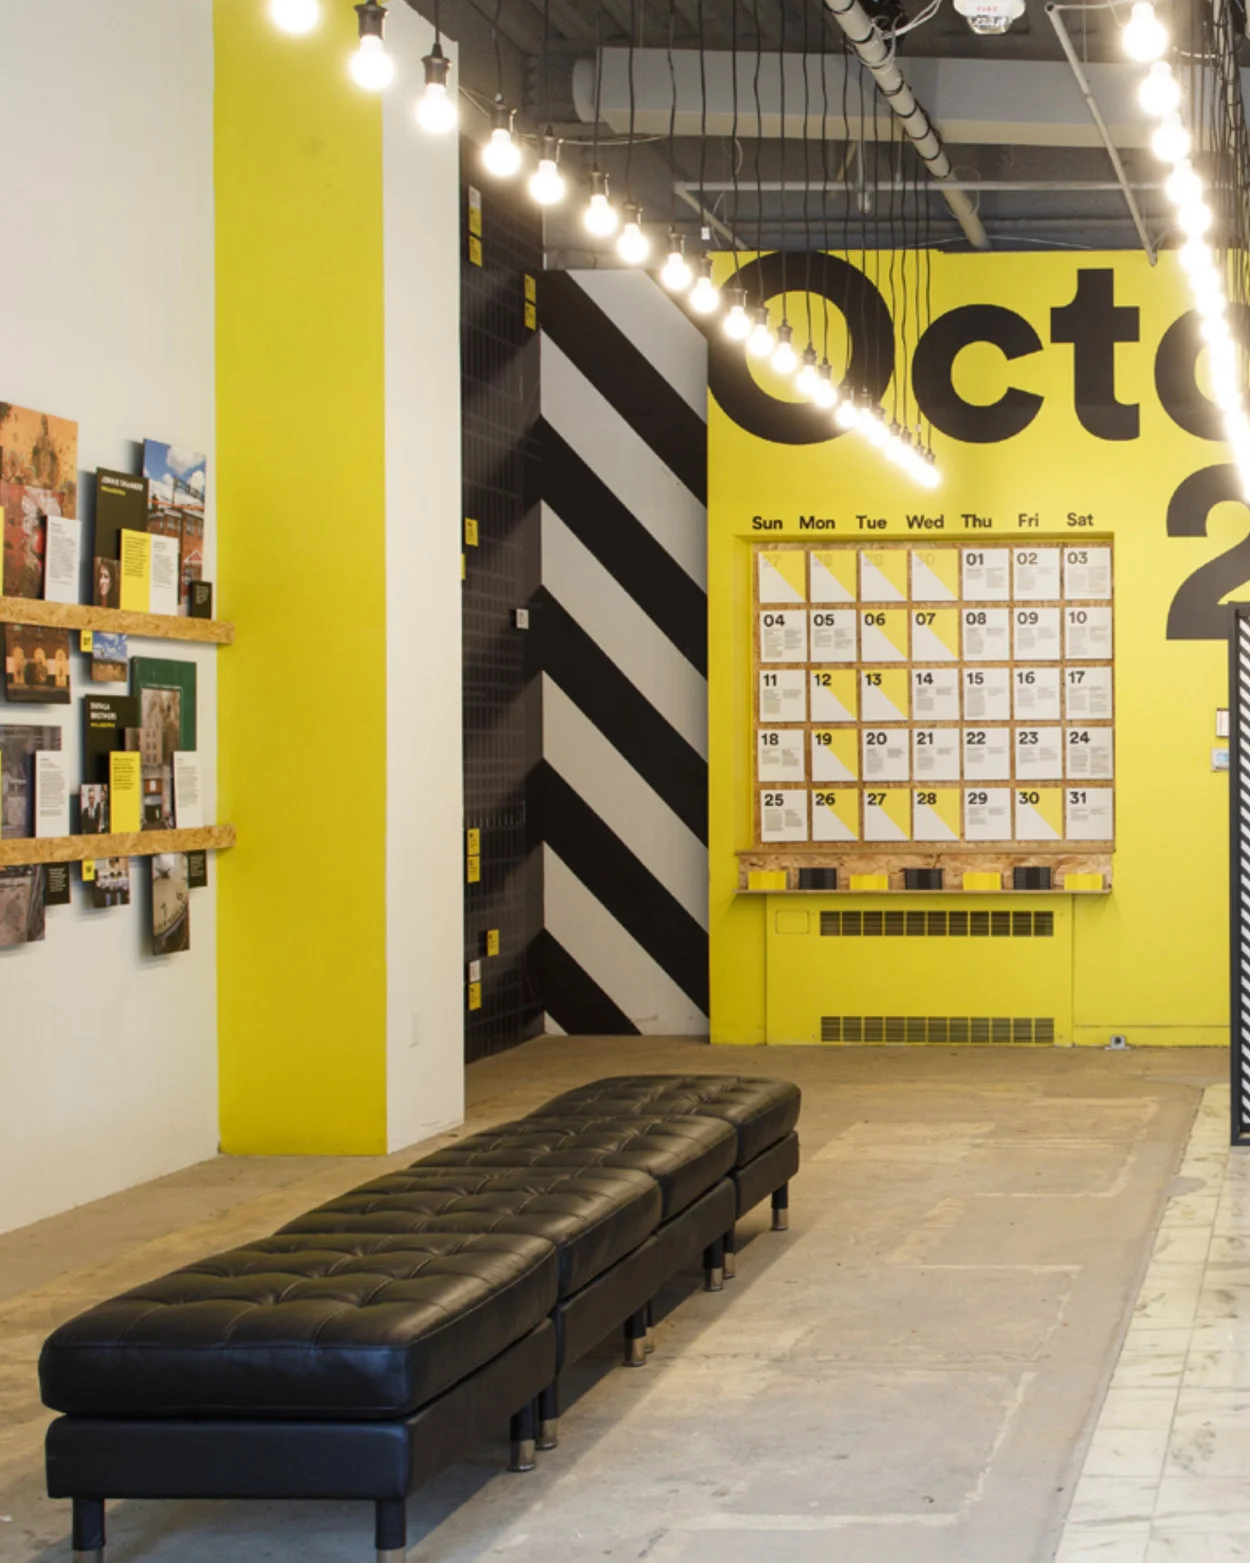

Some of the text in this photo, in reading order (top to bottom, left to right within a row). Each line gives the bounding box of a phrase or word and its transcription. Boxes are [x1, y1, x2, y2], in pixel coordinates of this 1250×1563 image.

[752, 513, 1093, 531] Sun Mon Tue Wed Thu Fri Sat
[967, 553, 983, 566] 01
[1017, 553, 1037, 565] 02
[1068, 552, 1087, 564] 03
[764, 611, 1087, 627] 04 05 06 07 08 09 10
[764, 671, 1084, 686] 11 12 13 14 15 16 17
[762, 732, 1089, 745] 18 19 20 21 22 23 24
[765, 792, 1086, 806] 25 26 27 28 29 30 31
